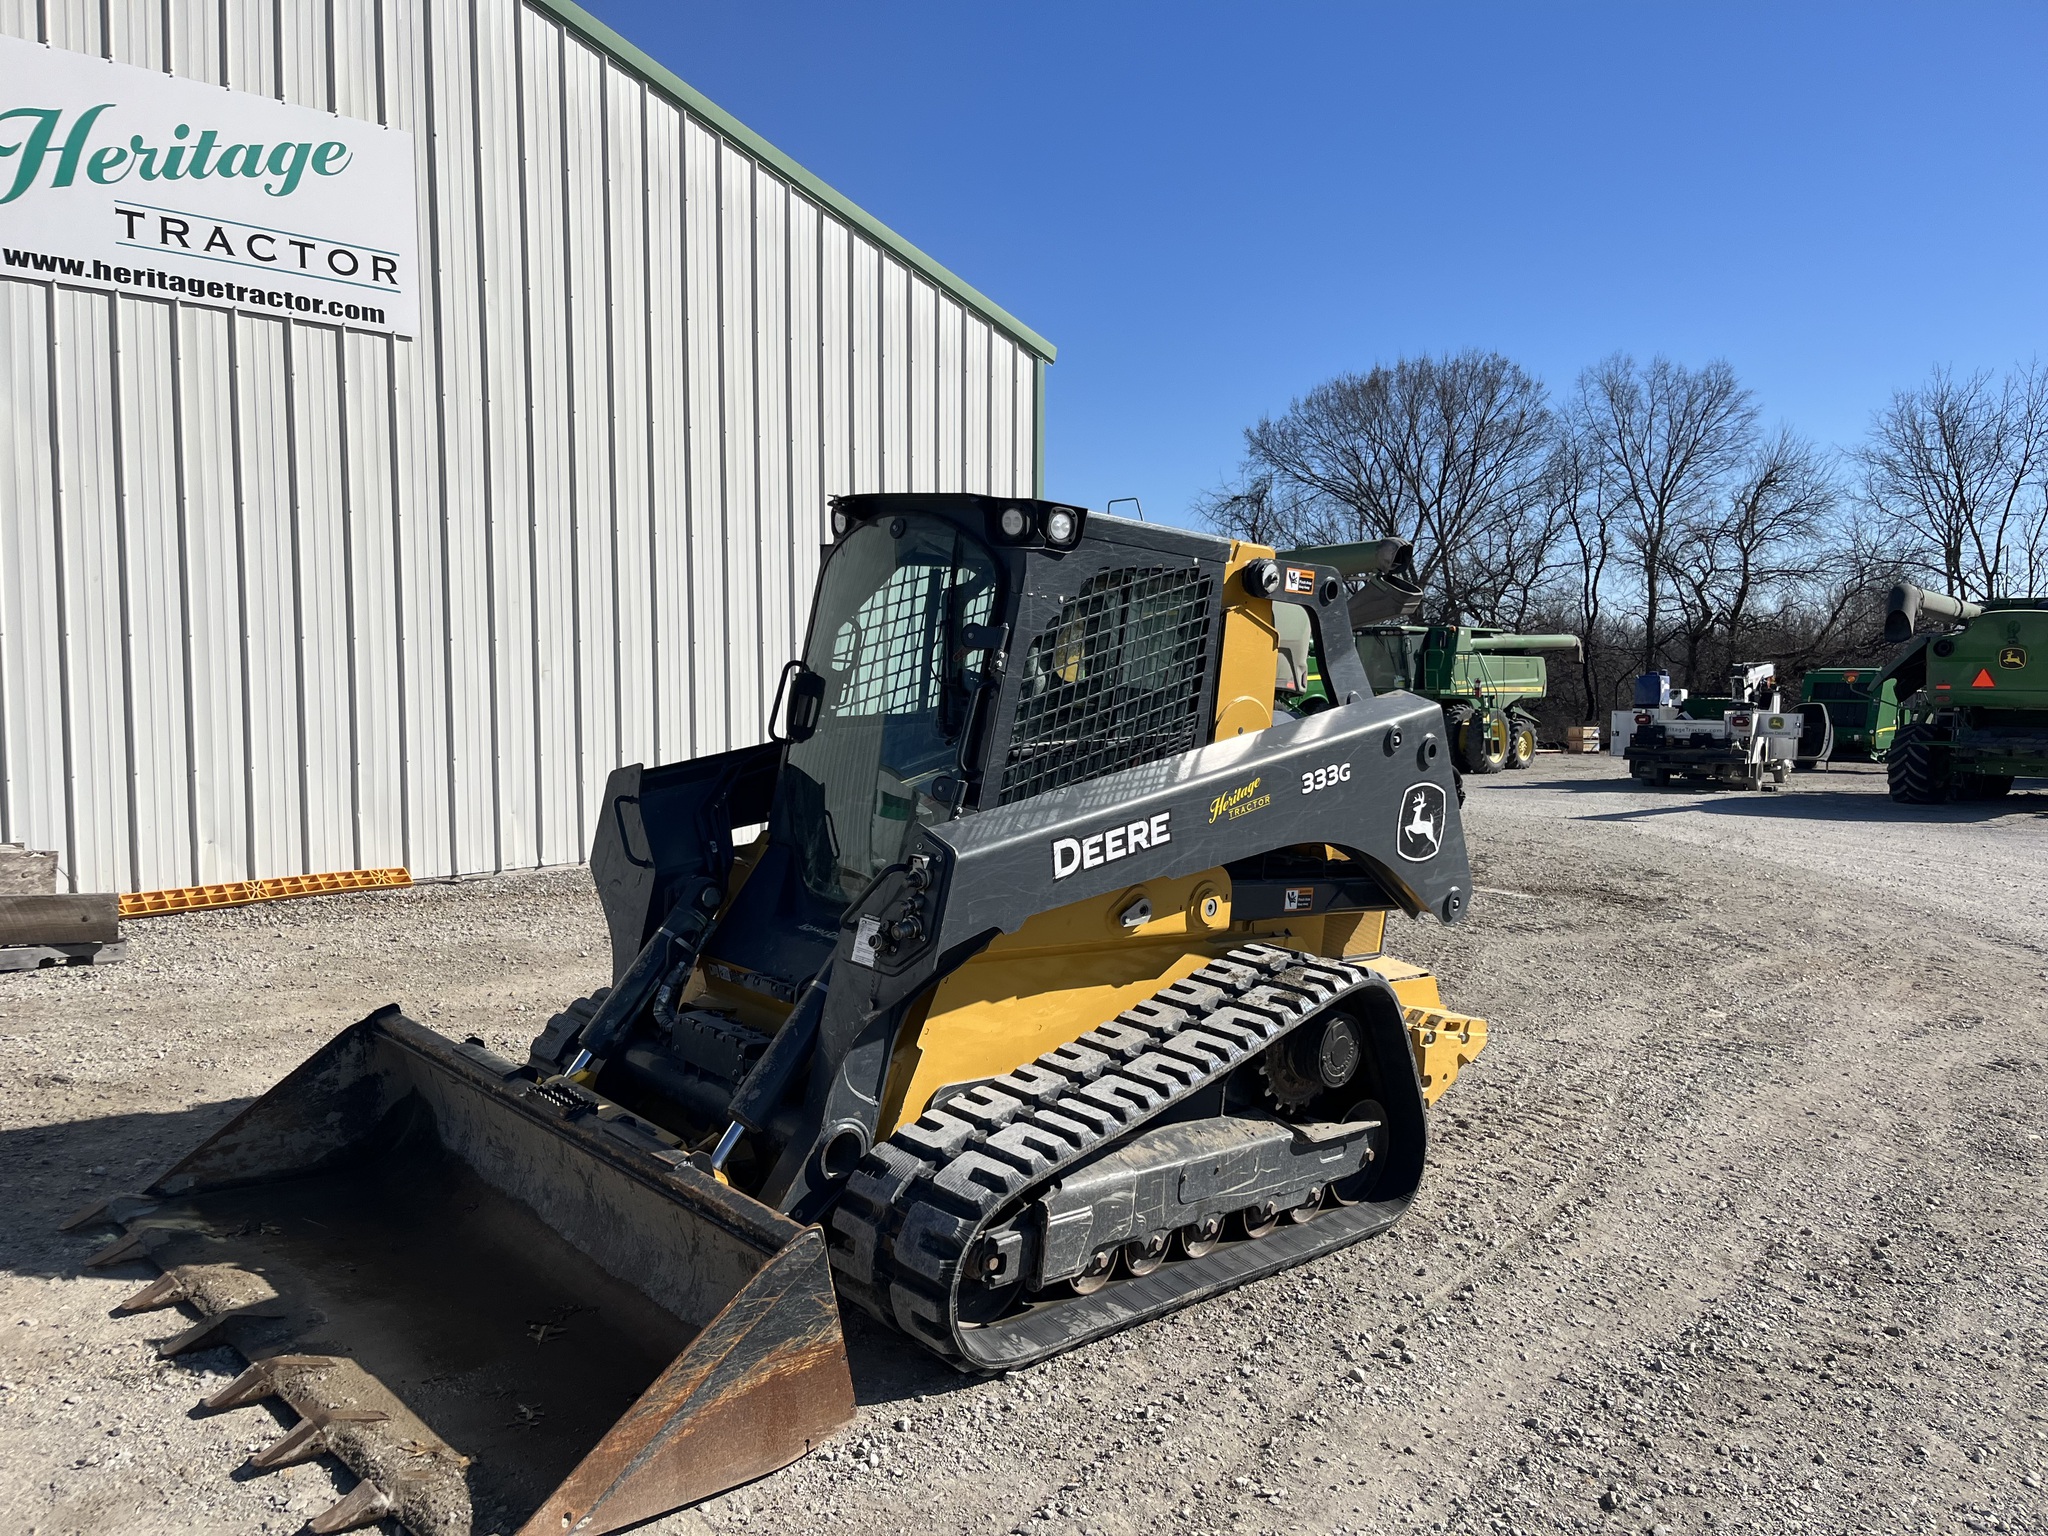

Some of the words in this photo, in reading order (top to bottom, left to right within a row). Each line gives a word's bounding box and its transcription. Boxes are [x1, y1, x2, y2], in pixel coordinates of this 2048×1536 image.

[0, 104, 353, 205] Heritage
[115, 207, 399, 285] TRACTOR
[2, 248, 386, 324] www.heritagetractor.com
[1208, 777, 1261, 824] Heritage
[1229, 795, 1270, 818] TRACTOR
[1301, 763, 1350, 794] 333G
[1053, 812, 1171, 880] DEERE
